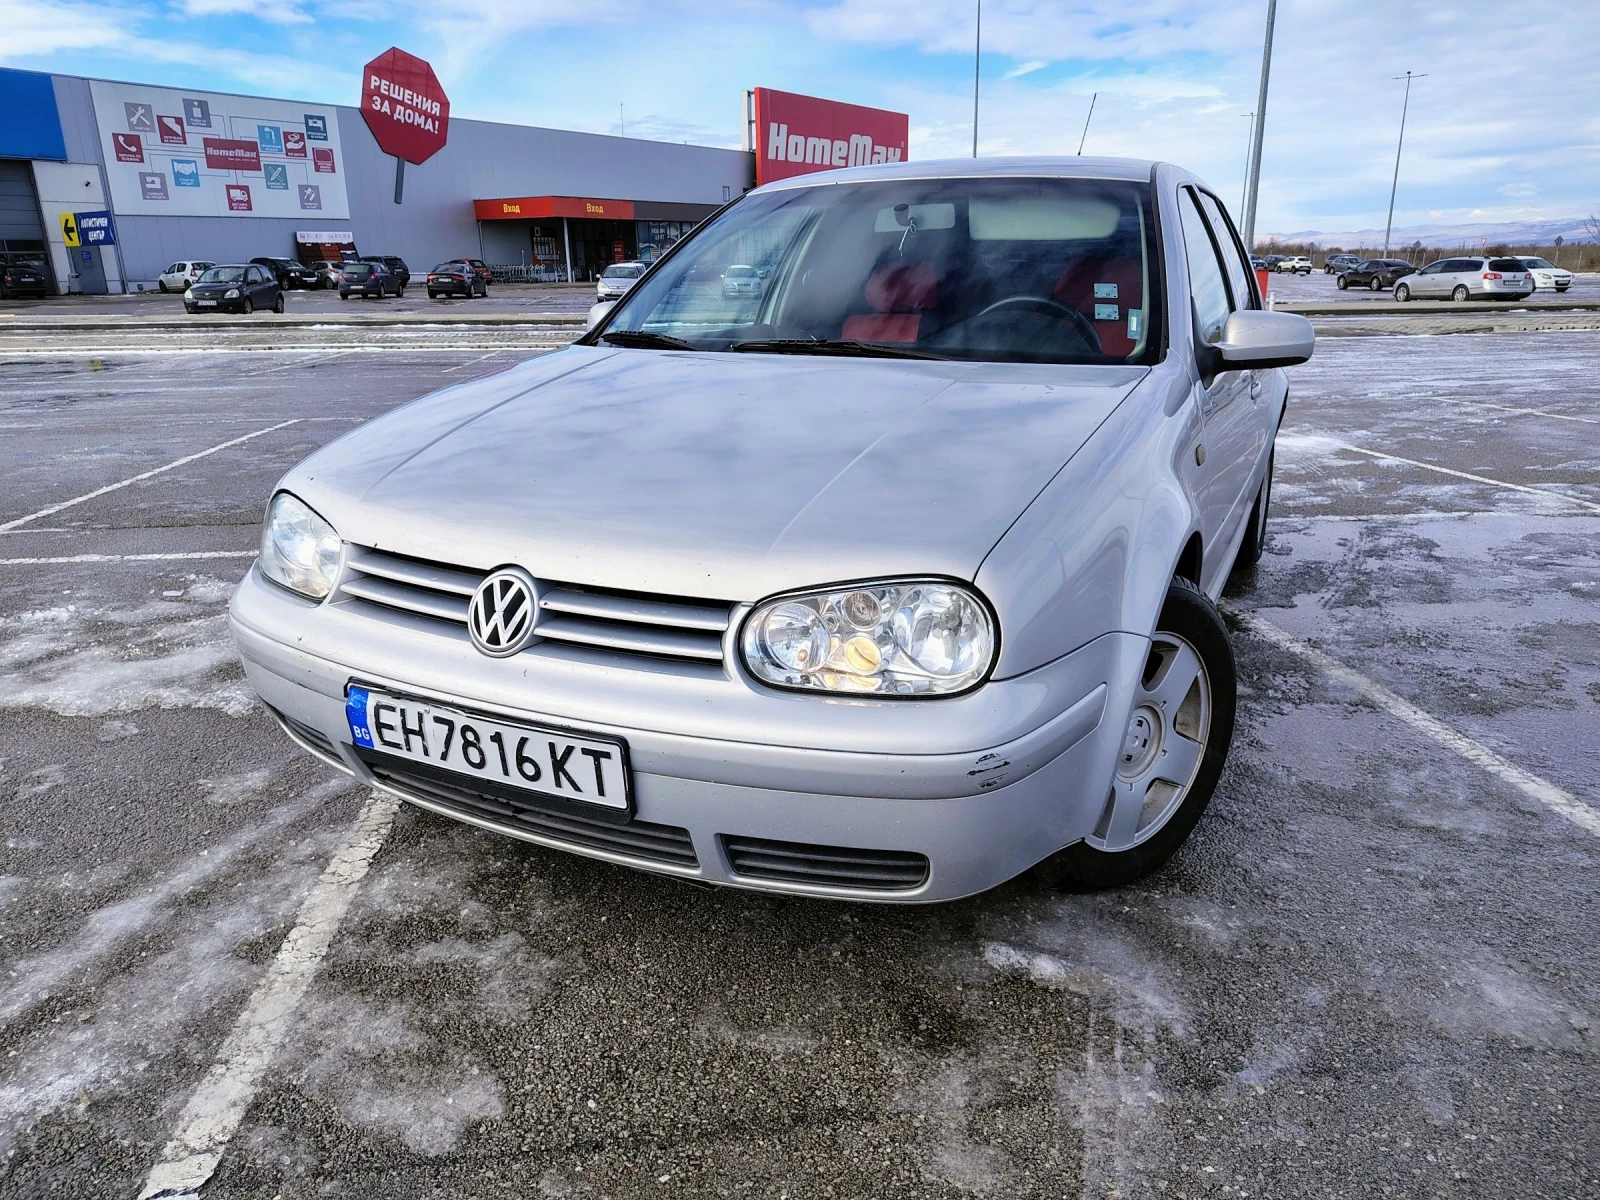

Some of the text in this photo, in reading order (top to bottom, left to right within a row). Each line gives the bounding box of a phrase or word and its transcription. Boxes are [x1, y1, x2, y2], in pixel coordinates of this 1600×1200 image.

[370, 75, 441, 117] РЕШЕНИЯ
[371, 95, 439, 135] ЗА ДОМА!
[206, 146, 257, 158] HomeMax
[767, 121, 902, 167] HomeMax
[503, 203, 521, 214] Вход
[586, 203, 604, 214] Вход
[353, 725, 371, 741] BG
[374, 700, 614, 797] EH7816KT
